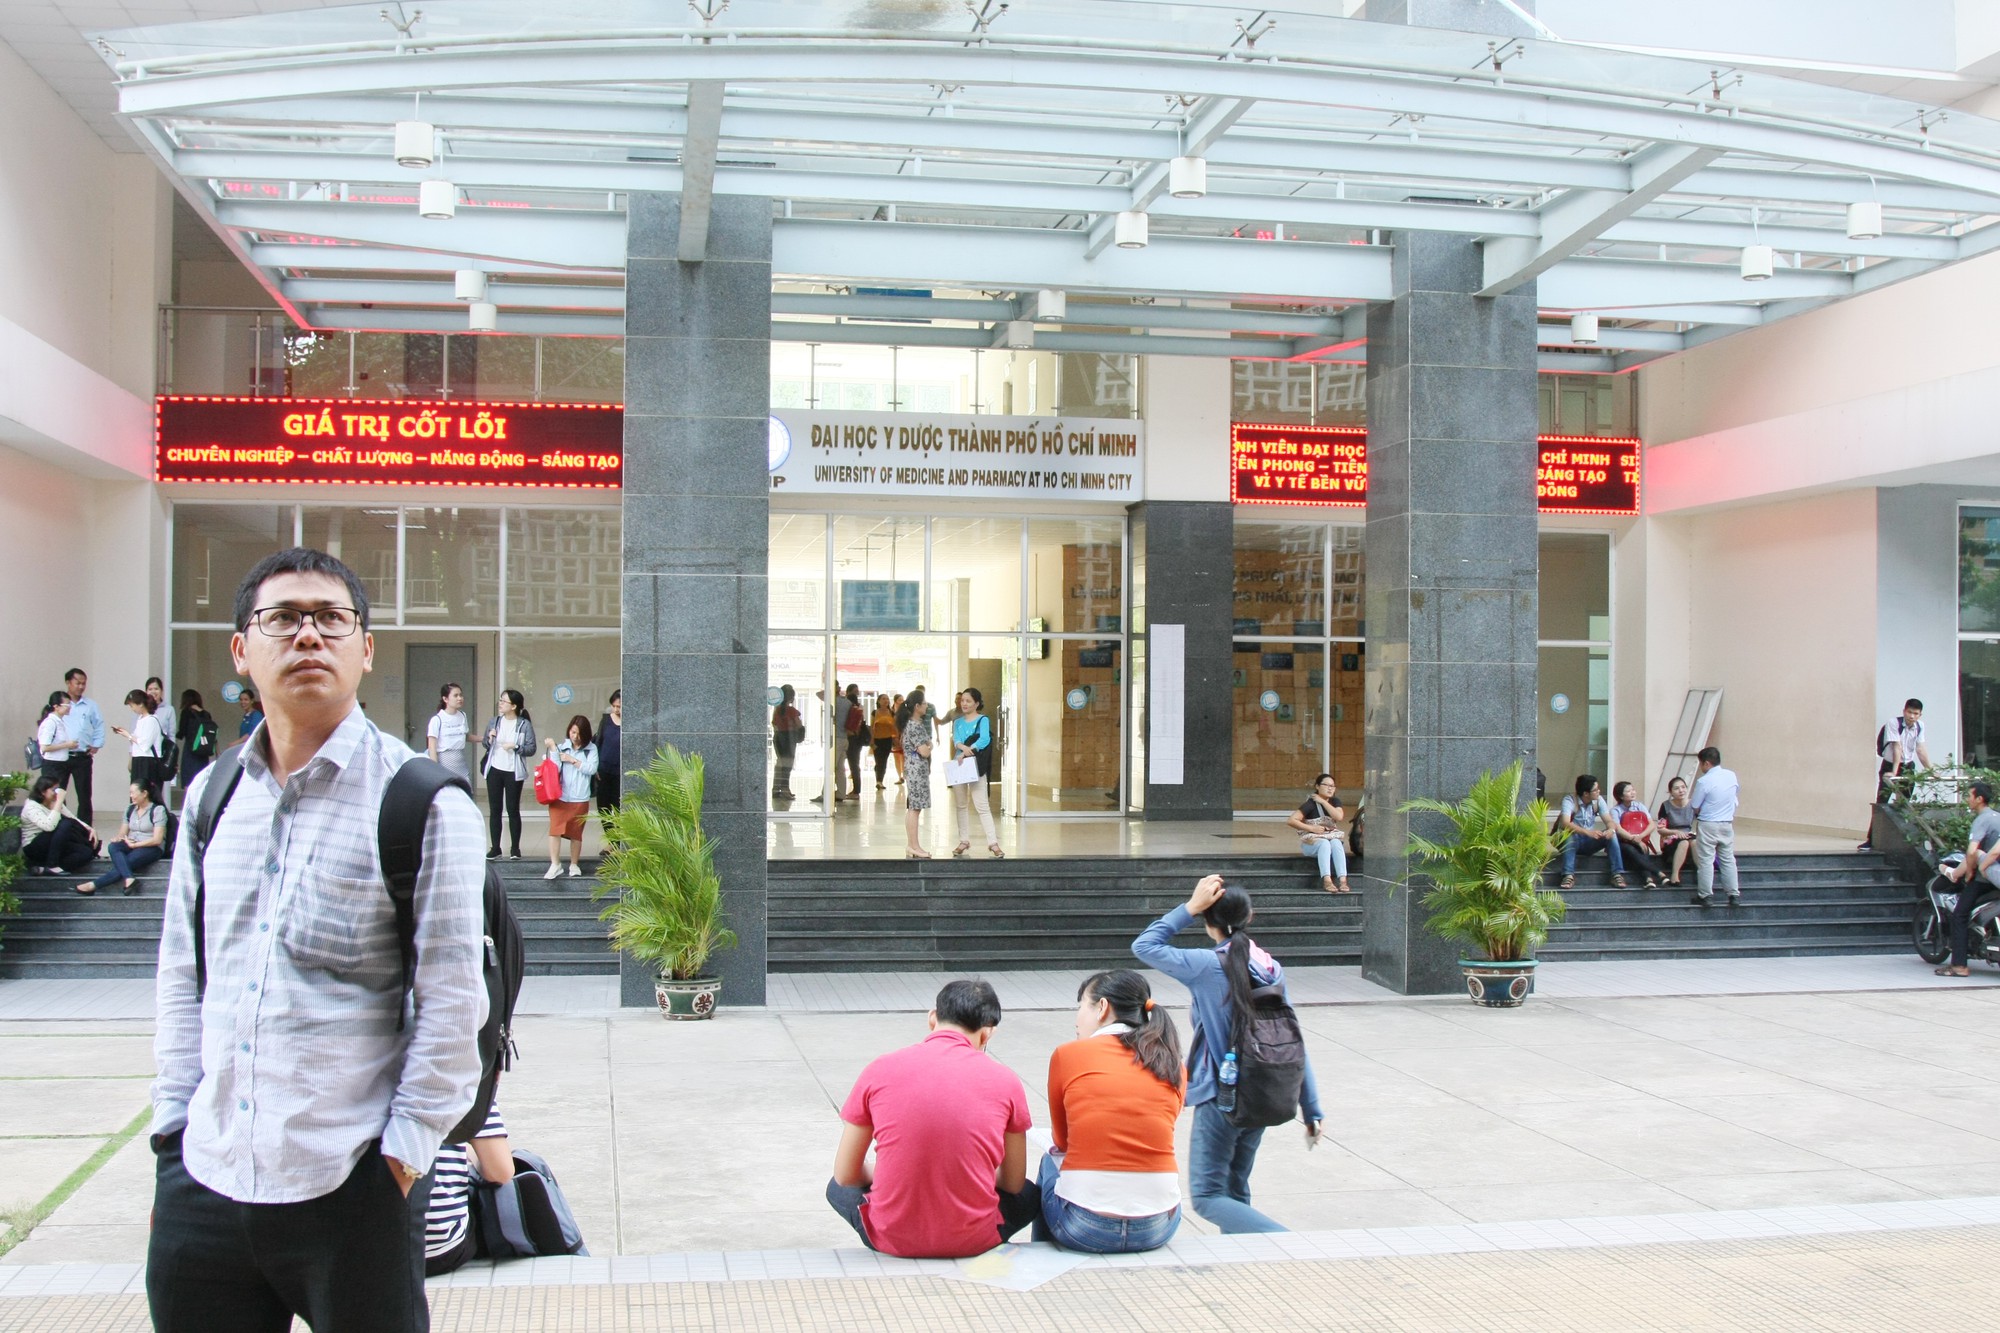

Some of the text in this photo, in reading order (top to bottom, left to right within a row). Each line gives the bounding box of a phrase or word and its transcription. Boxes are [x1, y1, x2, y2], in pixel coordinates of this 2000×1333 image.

[284, 408, 506, 441] GIÁ TRỊ CỐT LÕI
[811, 421, 1137, 458] ĐẠI HỌC Y DƯỢC THÀNH PHỐ HỒ CHÍ MINH
[1261, 439, 1297, 454] VIÊN
[1302, 443, 1329, 458] ĐẠI
[1334, 444, 1364, 459] HỌC
[167, 445, 230, 462] CHUYÊN
[234, 446, 294, 465] NGHIỆP
[312, 446, 352, 463] CHẤT
[357, 449, 413, 467] LƯỢNG
[430, 450, 475, 466] NĂNG
[480, 450, 524, 468] ĐỘNG
[542, 451, 585, 468] SÁNG
[588, 455, 619, 470] TẠO
[1262, 459, 1315, 472] PHONG
[1541, 449, 1567, 464] CHÍ
[1571, 453, 1610, 465] MINH
[815, 465, 1132, 490] UNIVERSITY OF MEDICINE AND PHARMACY AT HO CHI MINH CITY
[1275, 476, 1285, 488] Y
[1289, 473, 1308, 489] TẾ
[1311, 474, 1340, 490] BỀN
[1538, 465, 1574, 480] SÁNG
[1578, 470, 1606, 484] TẠO
